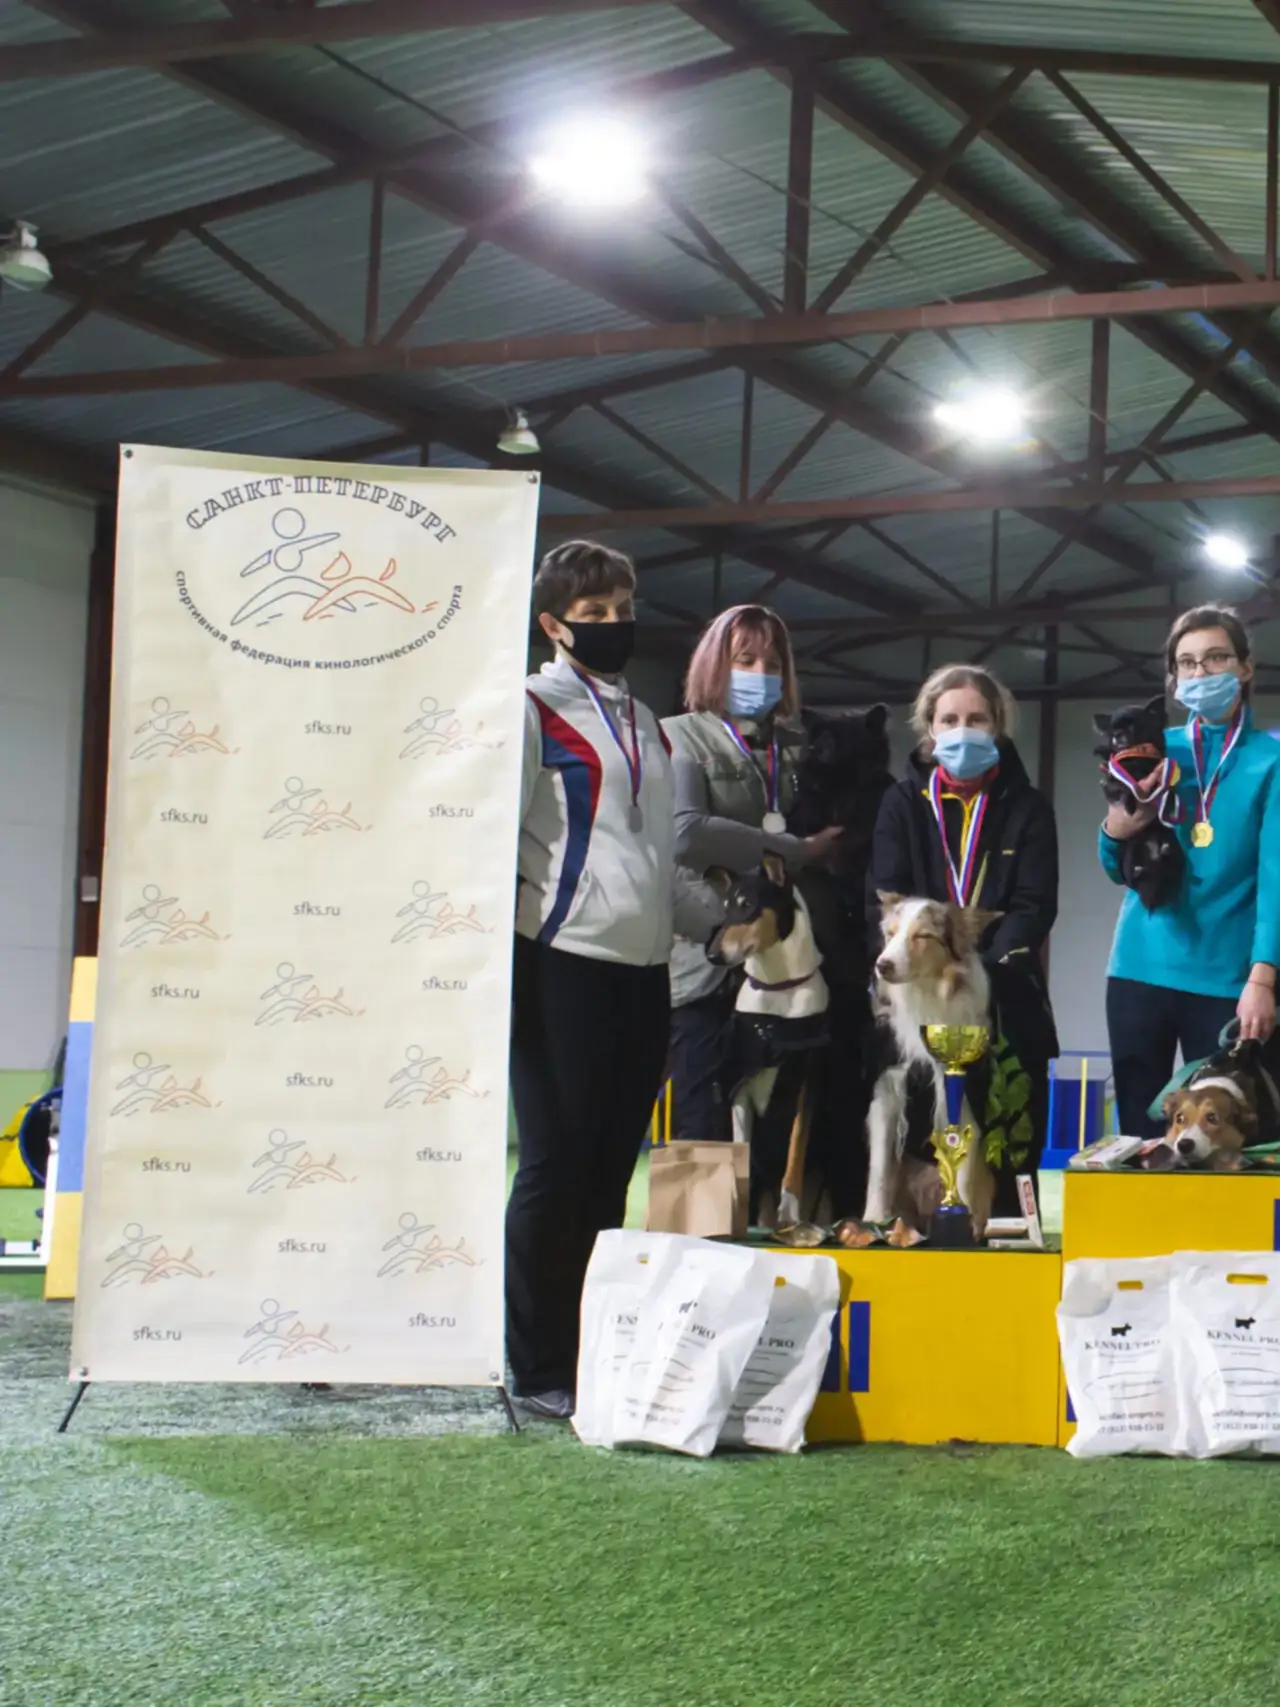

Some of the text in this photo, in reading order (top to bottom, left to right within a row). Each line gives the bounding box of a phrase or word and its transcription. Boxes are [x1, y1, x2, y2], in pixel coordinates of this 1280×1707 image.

[186, 475, 458, 543] САНКТ-ПЕТЕРБУРГ
[175, 569, 464, 670] спортивная федерация кинологического спорта
[305, 720, 352, 736] sfks.ru
[160, 808, 208, 825] sfks.ru
[429, 803, 475, 818] sfks.ru
[293, 901, 341, 917] sfks.ru
[151, 984, 200, 999] sfks.ru
[422, 976, 468, 991] sfks.ru
[286, 1072, 334, 1088] sfks.ru
[416, 1147, 462, 1162] sfks.ru
[142, 1156, 191, 1172] sfks.ru
[278, 1238, 326, 1253] sfks.ru
[409, 1312, 456, 1328] sfks.ru
[133, 1325, 182, 1341] sfks.ru
